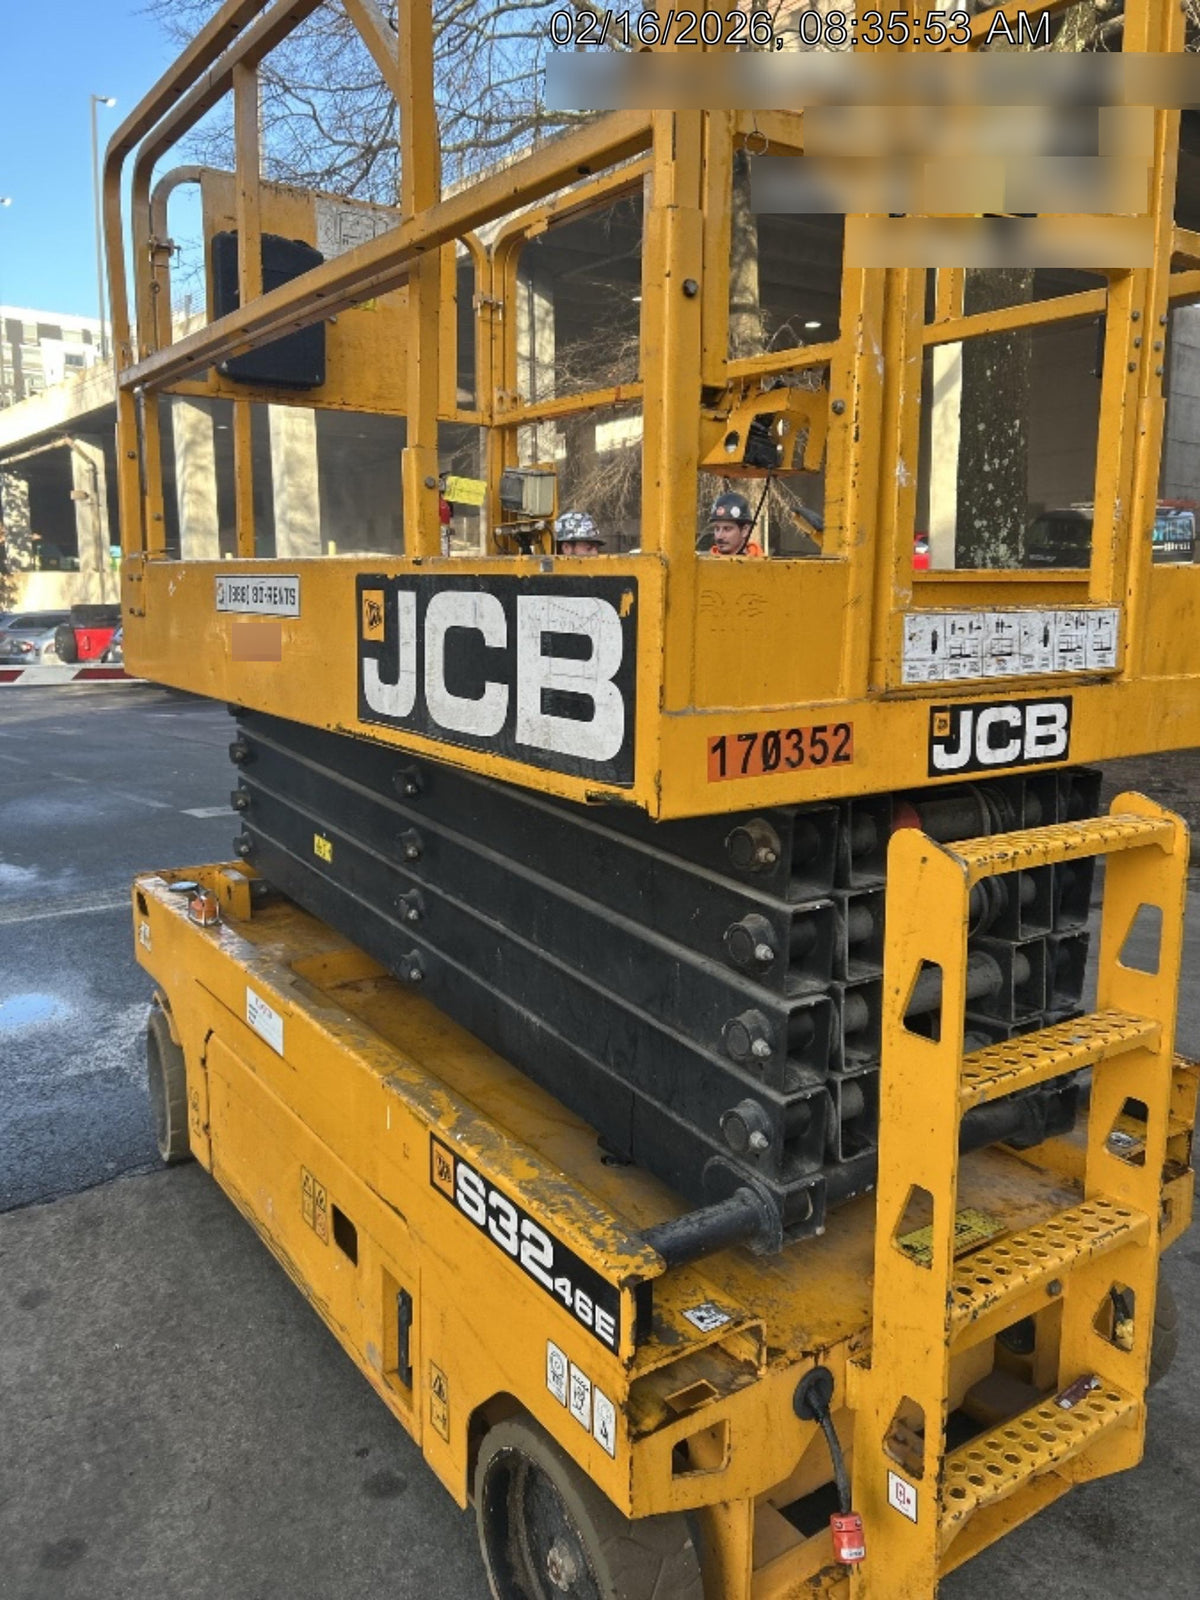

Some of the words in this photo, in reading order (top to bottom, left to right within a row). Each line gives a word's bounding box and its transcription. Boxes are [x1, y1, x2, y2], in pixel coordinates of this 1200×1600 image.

[363, 589, 625, 762] JCB
[711, 723, 852, 777] 170352
[932, 703, 1068, 770] JCB
